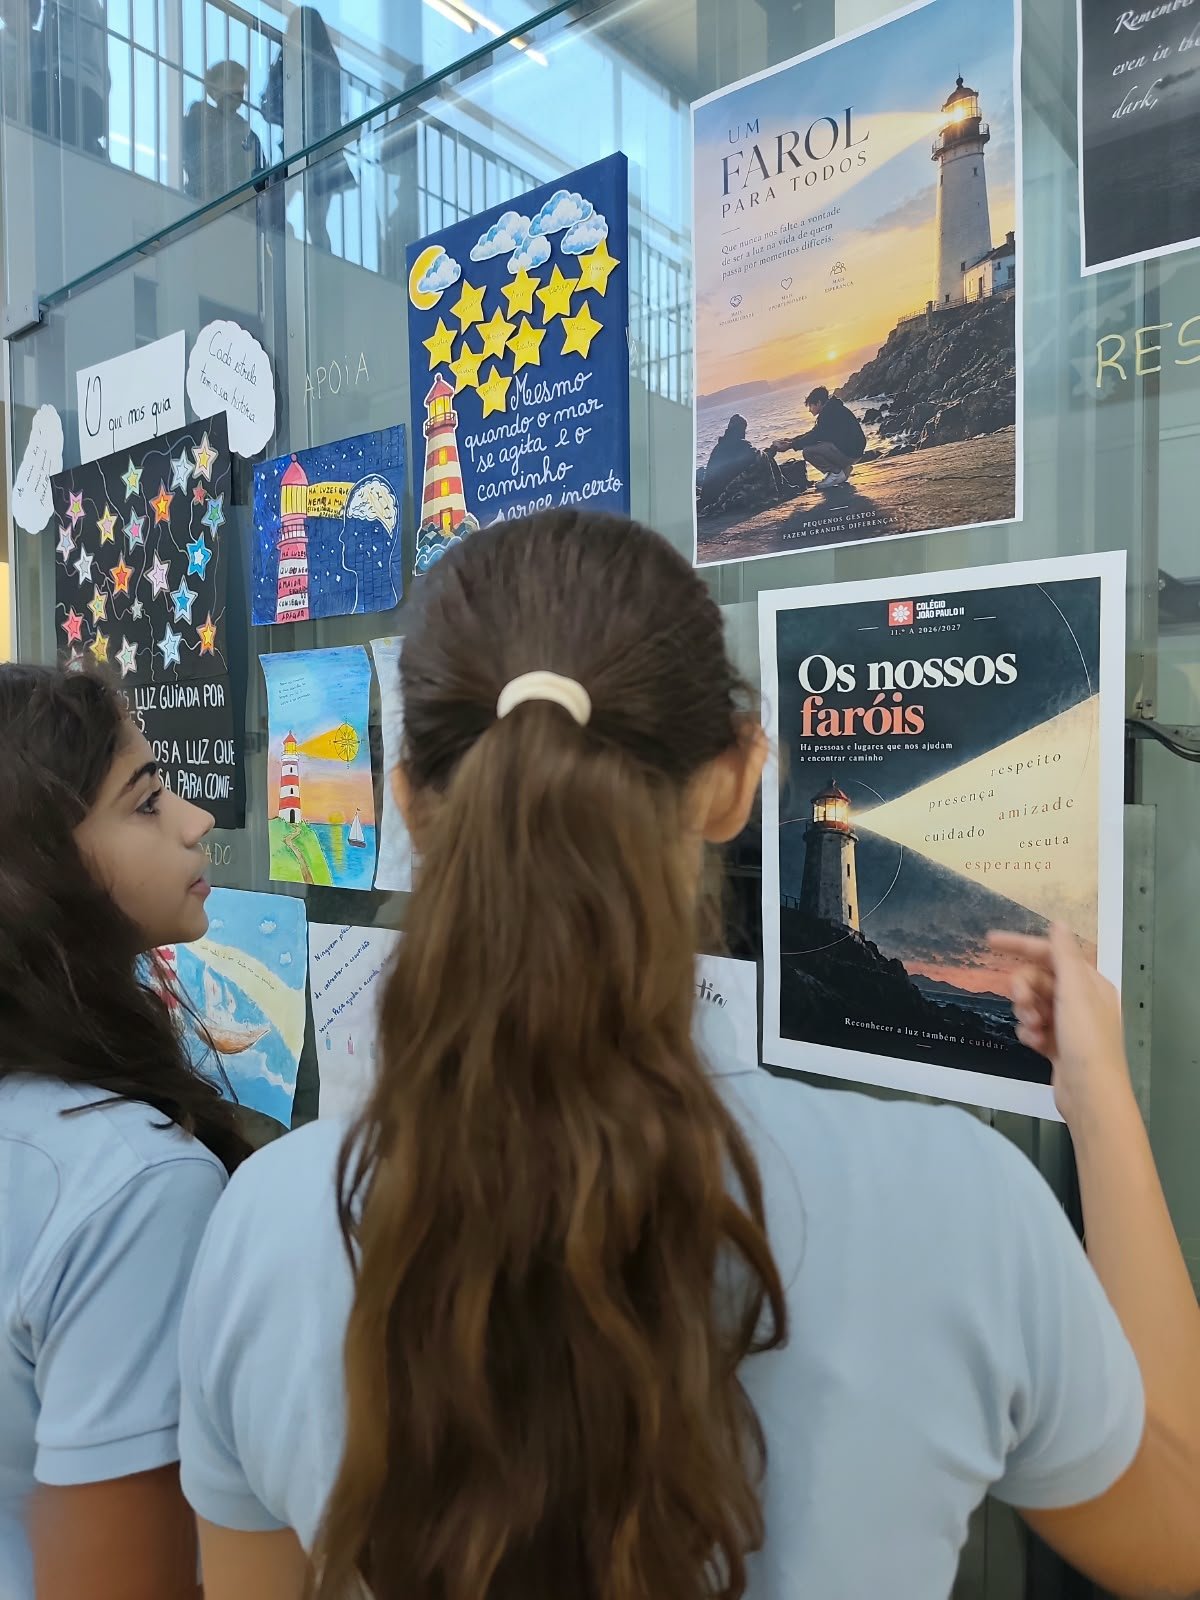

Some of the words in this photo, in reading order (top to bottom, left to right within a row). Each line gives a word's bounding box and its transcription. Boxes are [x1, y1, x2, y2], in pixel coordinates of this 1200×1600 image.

[1112, 56, 1147, 76] even
[1152, 45, 1171, 61] in
[1112, 78, 1162, 119] dark,
[728, 118, 760, 144] UM
[721, 105, 870, 197] FAROL
[722, 186, 776, 218] PARA
[790, 150, 867, 191] TODOS
[721, 245, 738, 255] Que
[739, 236, 762, 248] nunca
[764, 230, 778, 240] nos
[780, 221, 798, 233] falte
[807, 207, 841, 223] vontade
[721, 257, 731, 267] de
[733, 254, 744, 263] ser
[752, 246, 764, 256] luz
[766, 242, 776, 251] na
[779, 234, 795, 246] vida
[798, 230, 808, 240] de
[810, 223, 833, 237] quem
[722, 266, 742, 281] passa
[744, 261, 757, 273] por
[759, 247, 799, 265] momentos
[510, 371, 593, 410] Mesmo
[85, 375, 102, 437] O
[108, 415, 123, 453] que
[465, 413, 534, 462] quando
[537, 411, 551, 428] o
[553, 398, 604, 424] mar
[476, 452, 495, 473] se
[499, 433, 547, 476] agita
[555, 428, 570, 447] e
[575, 426, 592, 444] o
[477, 456, 574, 502] caminho
[783, 530, 807, 540] FAZEM
[809, 525, 846, 535] GRANDES
[848, 516, 899, 529] DIFERENÇAS
[803, 516, 843, 528] PEQUENOS
[846, 511, 876, 521] GESTOS
[916, 599, 946, 611] COLÉGIO
[916, 609, 935, 620] JOÃO
[936, 608, 958, 618] PAULO
[959, 607, 964, 616] II
[918, 624, 961, 634] 2026/2027
[798, 654, 856, 694] Os
[867, 653, 1018, 691] nossos
[134, 686, 157, 711] LUZ
[203, 684, 225, 707] POR
[800, 691, 925, 737] faróis
[171, 740, 182, 764] A
[186, 738, 210, 765] LUZ
[213, 739, 236, 766] QUE
[800, 743, 812, 751] Há
[814, 744, 844, 752] pessoas
[854, 742, 884, 752] lugares
[887, 744, 901, 752] que
[921, 741, 953, 751] ajudam
[849, 754, 884, 762] caminho
[991, 753, 1061, 776] respeito
[177, 769, 201, 799] PARA
[929, 789, 994, 812] presença
[998, 796, 1074, 820] amizade
[924, 826, 985, 842] cuidado
[1019, 836, 1069, 849] escuta
[965, 860, 1052, 873] esperança
[845, 1017, 894, 1032] Reconhecer
[905, 1026, 919, 1036] luz
[922, 1030, 957, 1043] também
[960, 1036, 965, 1044] é
[968, 1038, 1008, 1050] cuidar.
